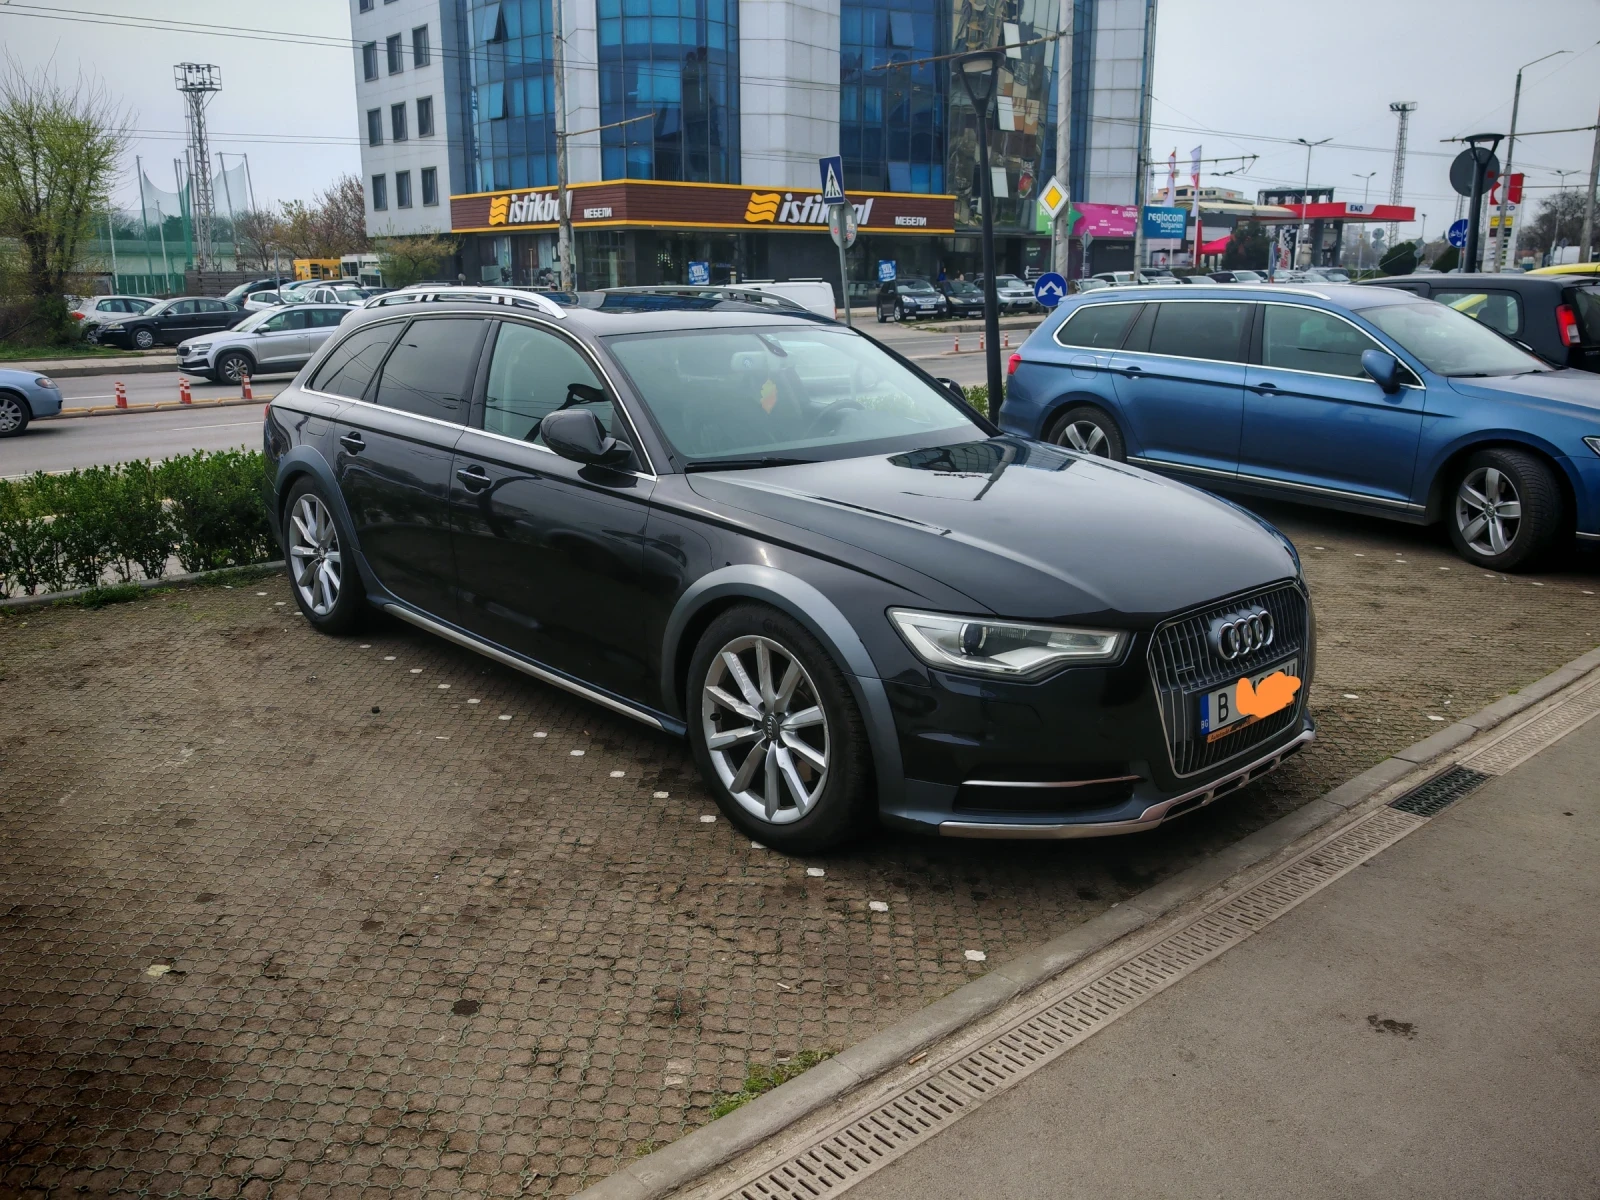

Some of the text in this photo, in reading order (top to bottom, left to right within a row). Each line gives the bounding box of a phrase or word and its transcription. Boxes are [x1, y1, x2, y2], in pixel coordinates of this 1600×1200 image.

[583, 207, 612, 219] МЕБЕЛИ
[778, 193, 874, 225] istikal
[1350, 204, 1364, 213] EKO
[895, 215, 927, 227] МЕБЕЛИ
[1147, 211, 1184, 224] regiocom
[1217, 692, 1230, 724] B
[1200, 719, 1209, 730] BG
